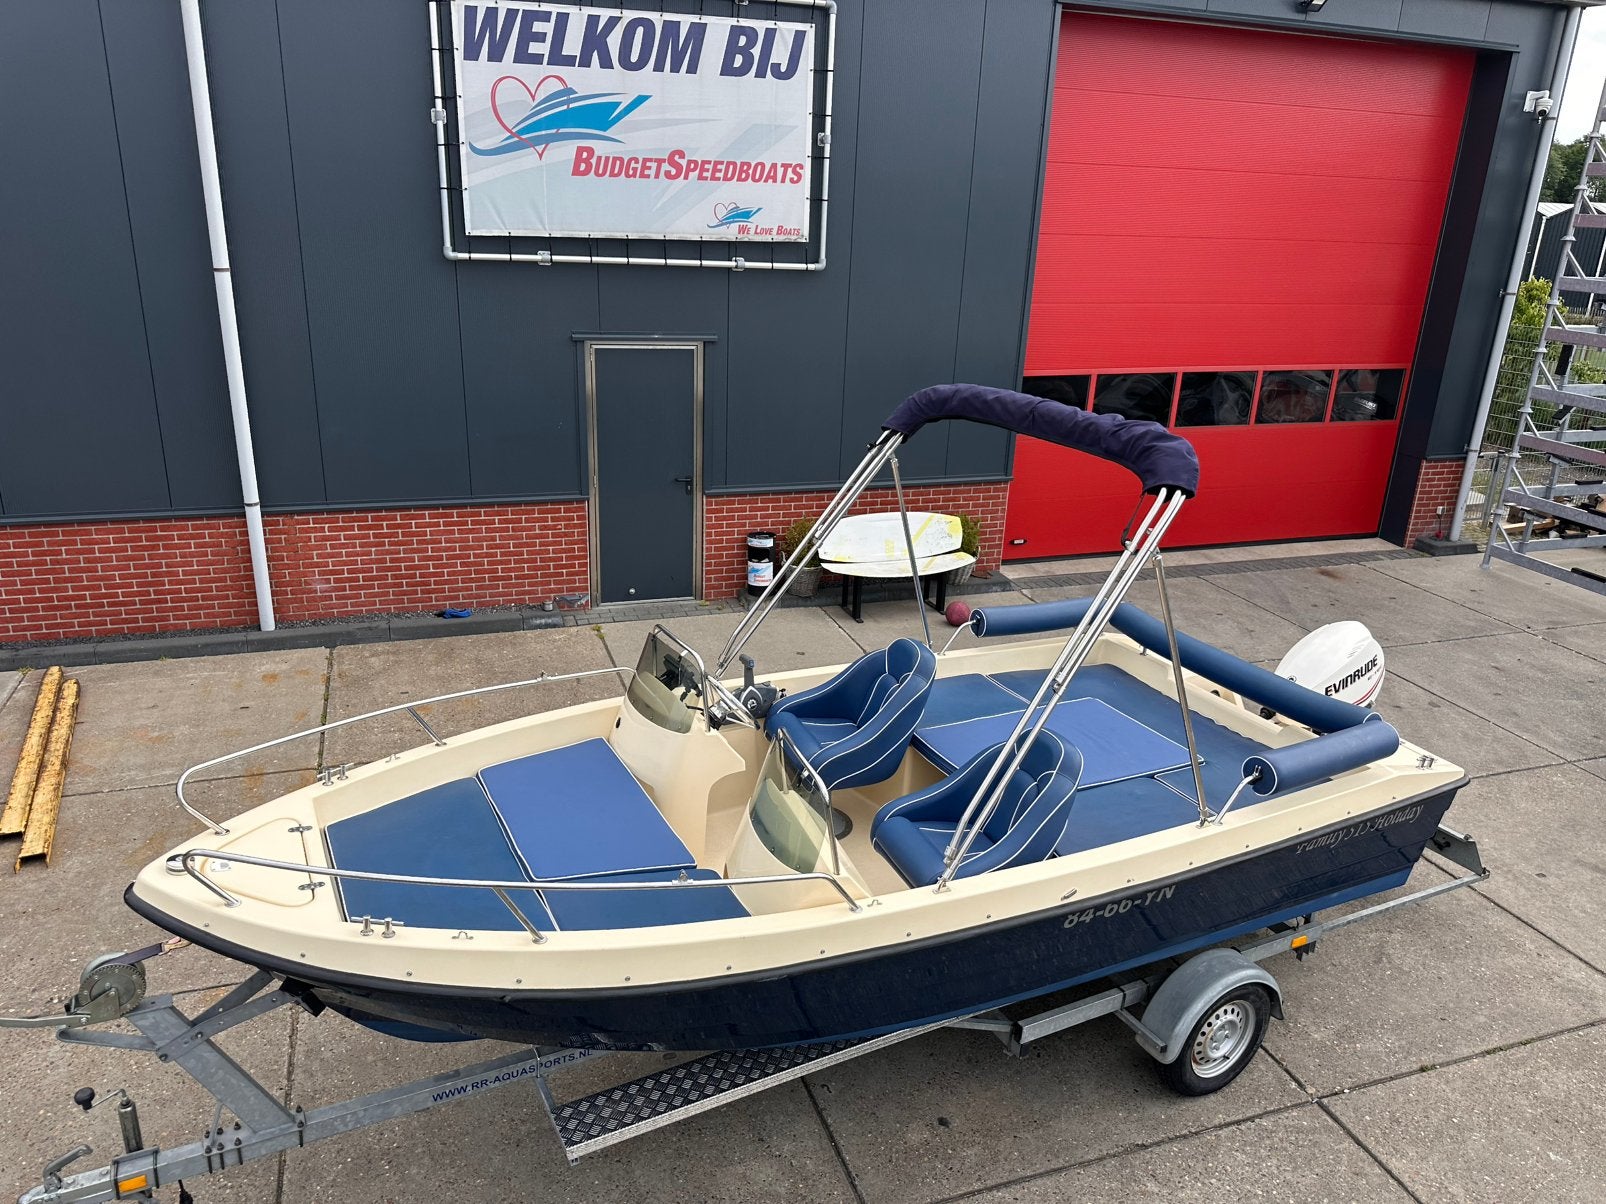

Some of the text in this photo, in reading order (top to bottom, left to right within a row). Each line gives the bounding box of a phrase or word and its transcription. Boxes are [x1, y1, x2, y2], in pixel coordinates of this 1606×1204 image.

[463, 5, 807, 81] WELKOM BIJ
[571, 146, 804, 185] BUDGETSPEEDBOATS
[737, 224, 801, 237] WE LOVE BOATS
[1324, 654, 1378, 697] EVINRUDE
[432, 1050, 594, 1102] WWW.RR-AQUASPORTS.NL
